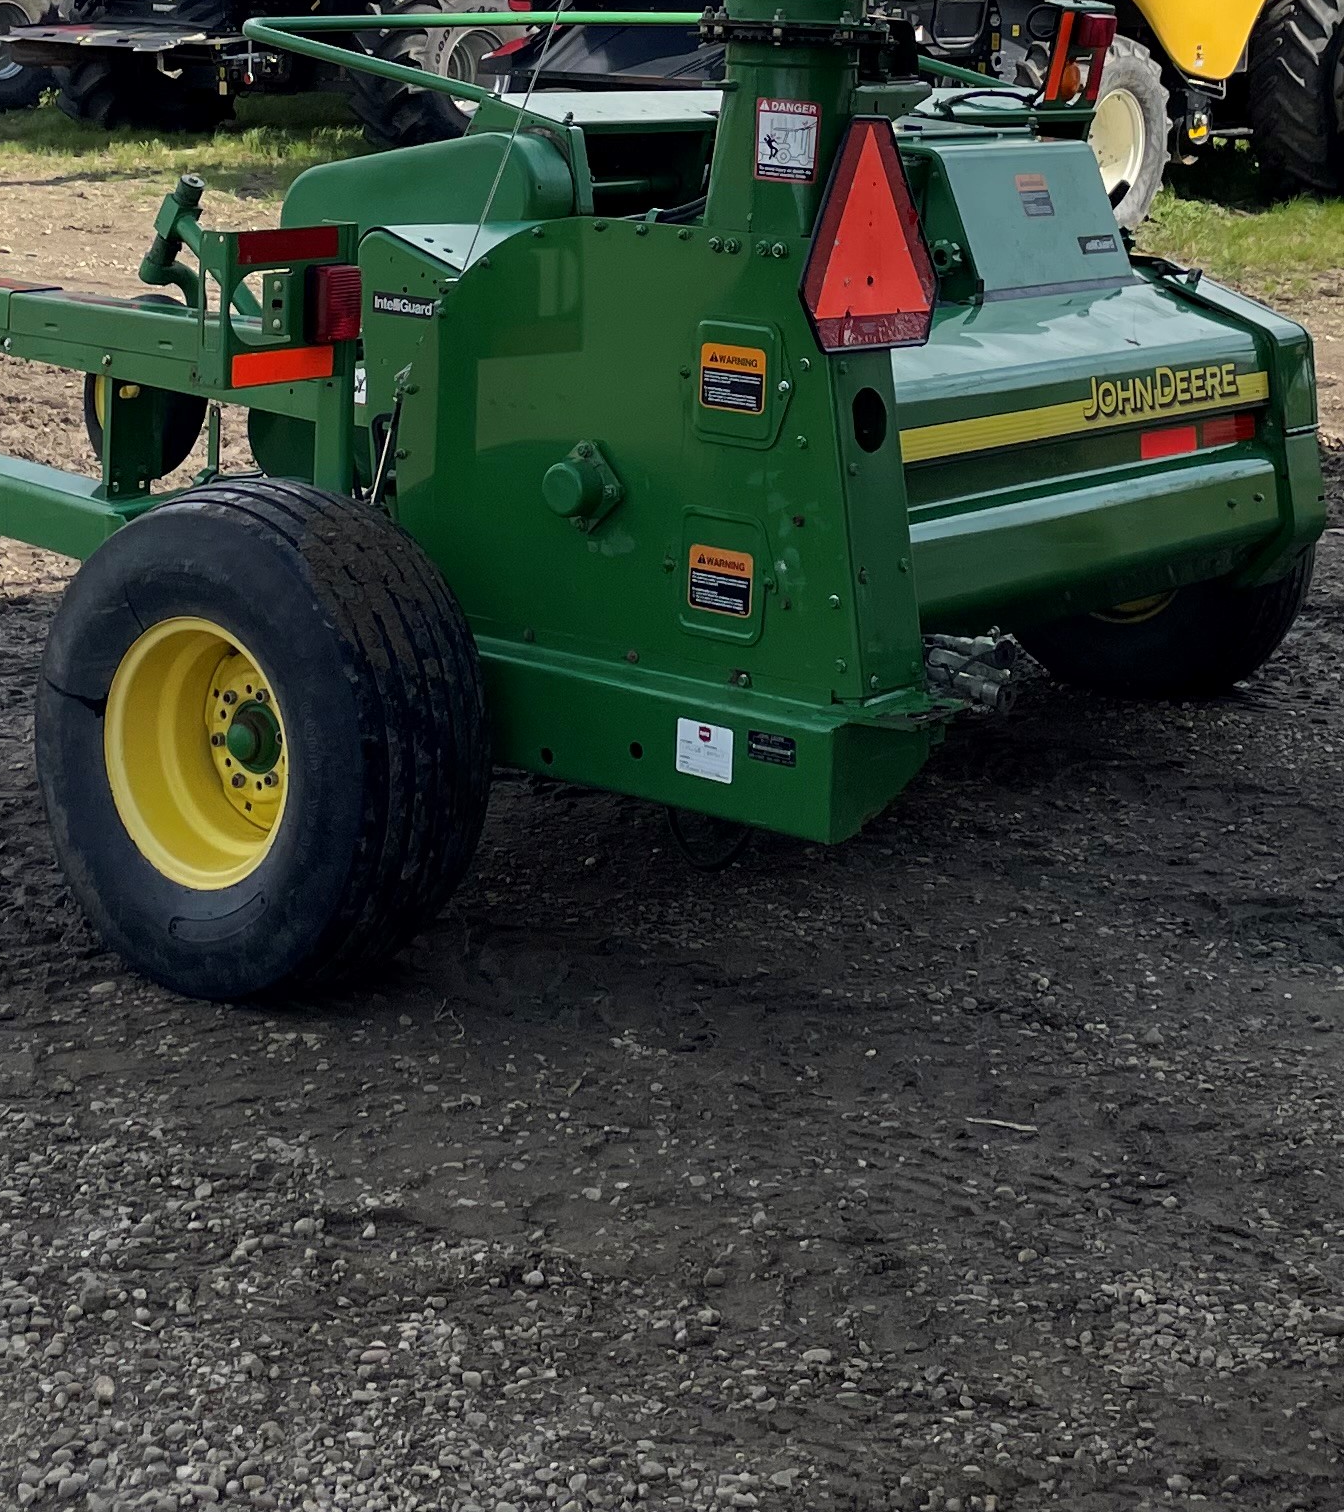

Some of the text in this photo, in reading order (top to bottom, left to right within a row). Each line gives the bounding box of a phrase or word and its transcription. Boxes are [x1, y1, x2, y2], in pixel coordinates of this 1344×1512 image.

[771, 101, 817, 114] DANGER
[374, 295, 433, 316] IntelliGuard
[719, 354, 758, 368] WARNING
[1083, 363, 1239, 420] JOHN DEERE
[706, 557, 746, 572] WARNING
